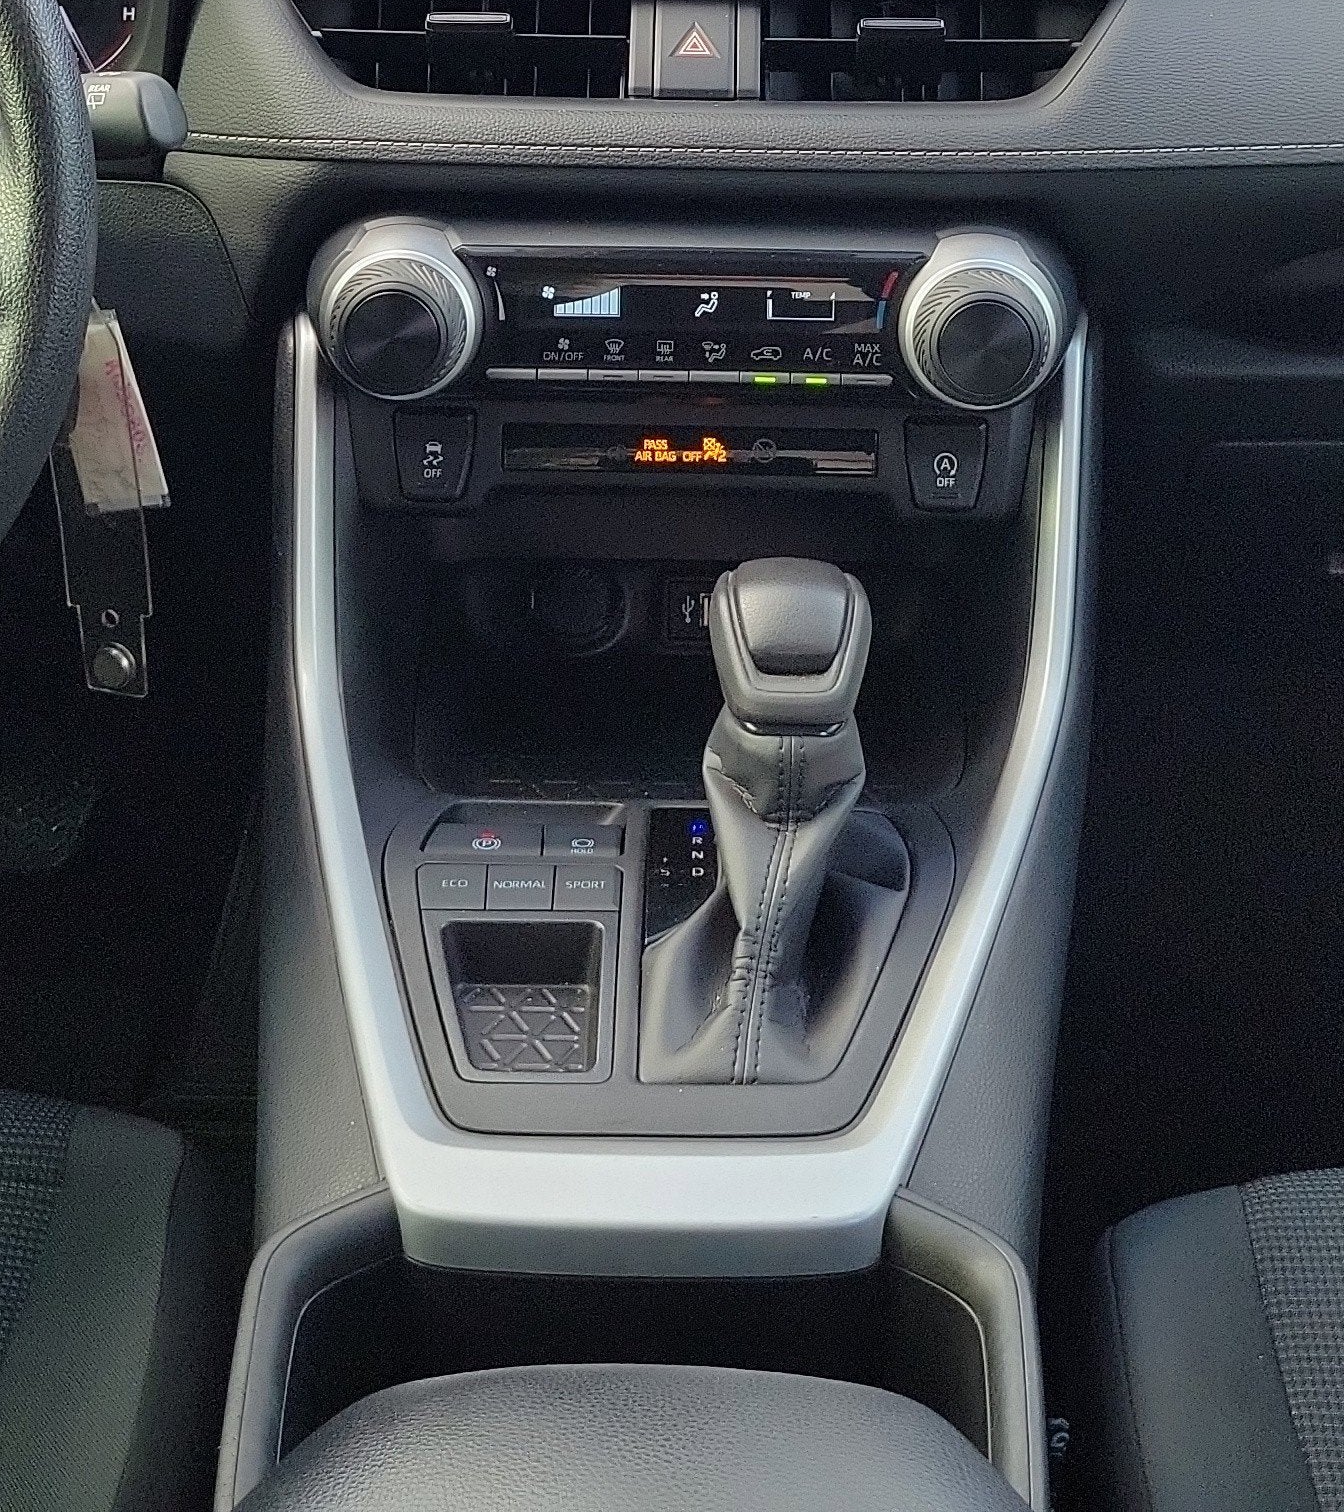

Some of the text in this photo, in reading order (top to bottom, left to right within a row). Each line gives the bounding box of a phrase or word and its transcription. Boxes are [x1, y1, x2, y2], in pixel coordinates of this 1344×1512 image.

[122, 7, 135, 21] H
[791, 291, 811, 299] TEMP
[855, 344, 880, 352] MAX
[543, 351, 584, 361] ON/OFF
[803, 348, 832, 361] A/C
[853, 354, 881, 366] A/C
[644, 439, 668, 450] PASS
[635, 451, 653, 462] AIR
[655, 451, 676, 462] BAG
[683, 451, 702, 462] OFF
[424, 468, 442, 478] OFF
[937, 478, 955, 487] OFF
[692, 851, 704, 859] N
[692, 867, 704, 876] D
[442, 879, 468, 887] ECO
[493, 880, 546, 888] NORMAL
[565, 880, 606, 889] SPORT
